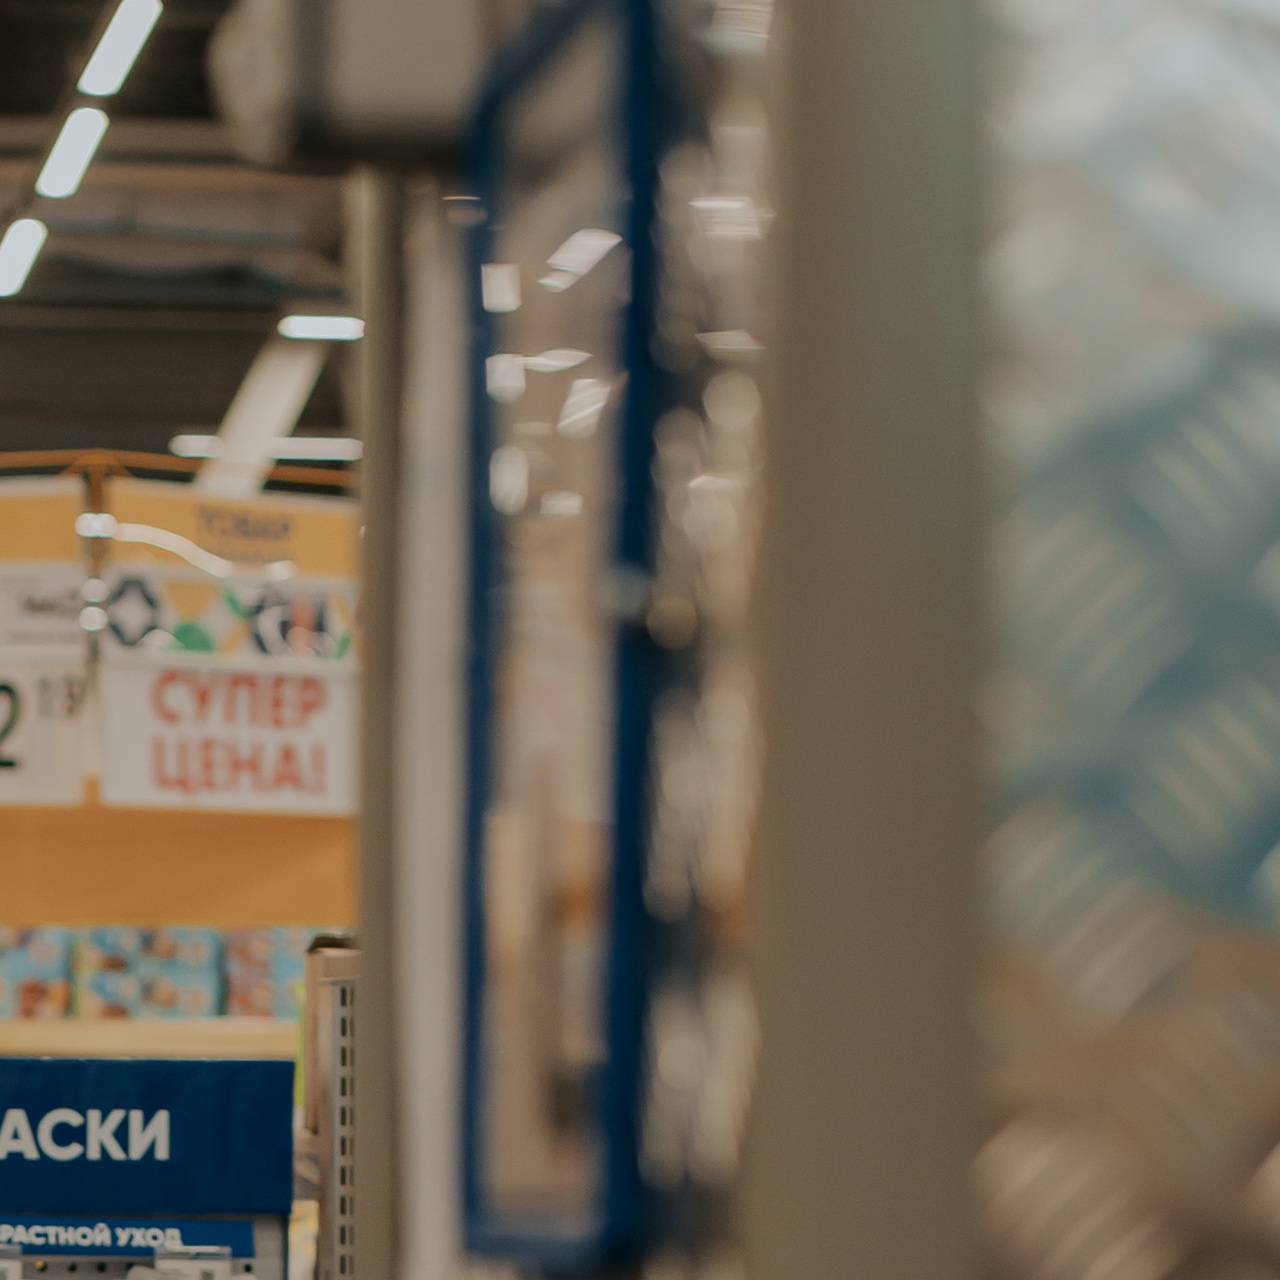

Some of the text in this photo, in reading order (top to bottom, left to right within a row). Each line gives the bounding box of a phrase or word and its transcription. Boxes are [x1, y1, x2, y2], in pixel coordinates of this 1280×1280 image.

[151, 669, 328, 728] СУПЕР
[151, 736, 328, 794] ЦЕНА!
[115, 1226, 184, 1248] УХОД
